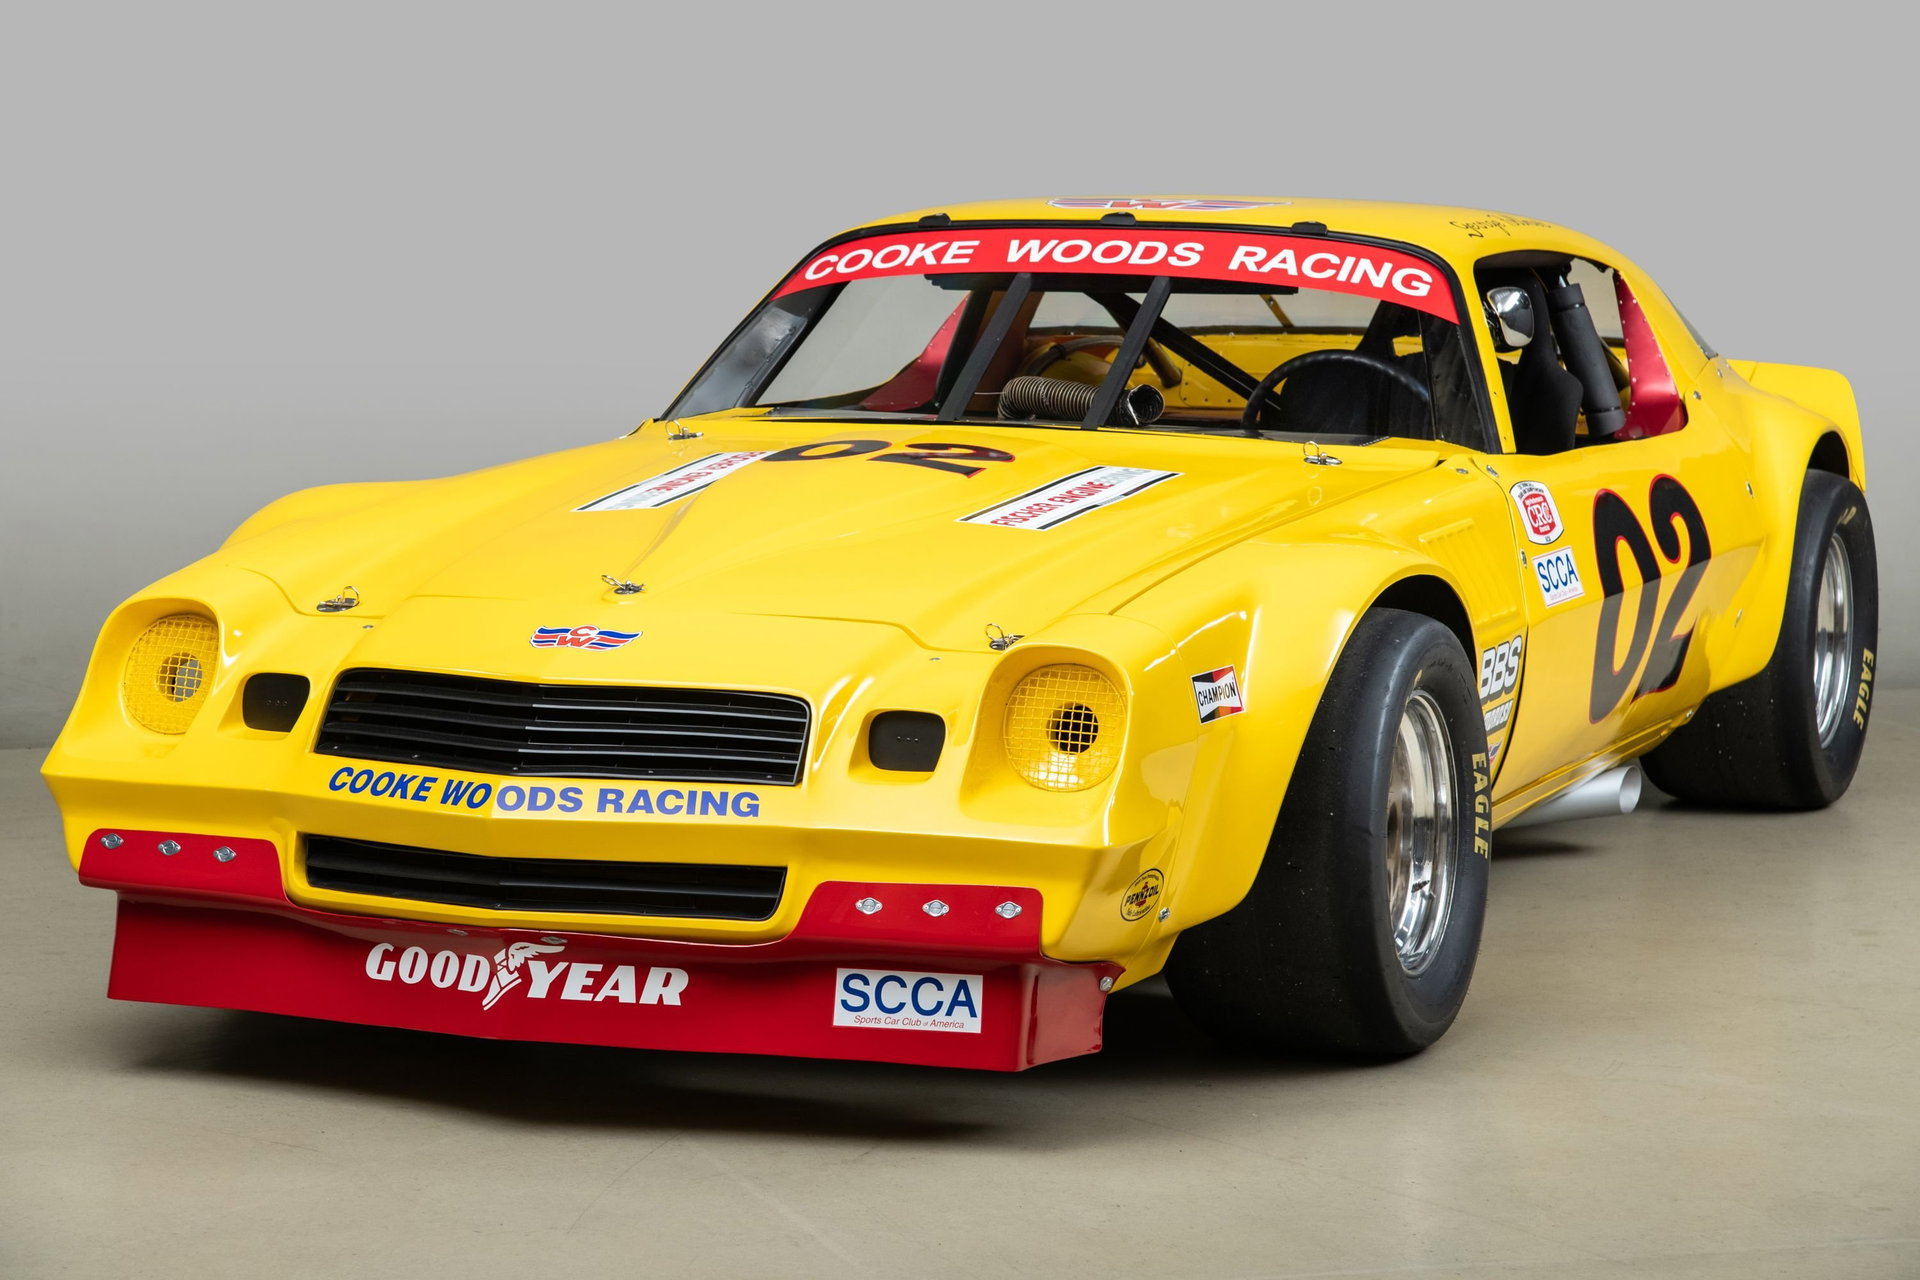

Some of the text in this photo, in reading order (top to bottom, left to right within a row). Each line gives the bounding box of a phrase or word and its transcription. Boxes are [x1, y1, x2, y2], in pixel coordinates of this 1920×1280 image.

[805, 240, 1432, 296] COOKE WOODS RACING
[760, 440, 1016, 479] 02
[990, 502, 1063, 526] FISCHER
[1527, 502, 1553, 528] CRC
[1537, 553, 1578, 593] SCCA
[1589, 473, 1712, 725] 02
[1480, 636, 1522, 701] BBS
[1853, 648, 1875, 730] EAGLE
[1197, 681, 1236, 707] CHAMPION
[329, 766, 759, 818] COOKE WOODS RACING
[1471, 752, 1489, 859] EAGLE
[1125, 884, 1159, 907] PENNZOIL
[840, 973, 978, 1018] SCCA
[853, 1014, 882, 1025] Sports
[884, 1016, 900, 1026] Car
[901, 1017, 922, 1027] Club
[930, 1018, 965, 1029] America
